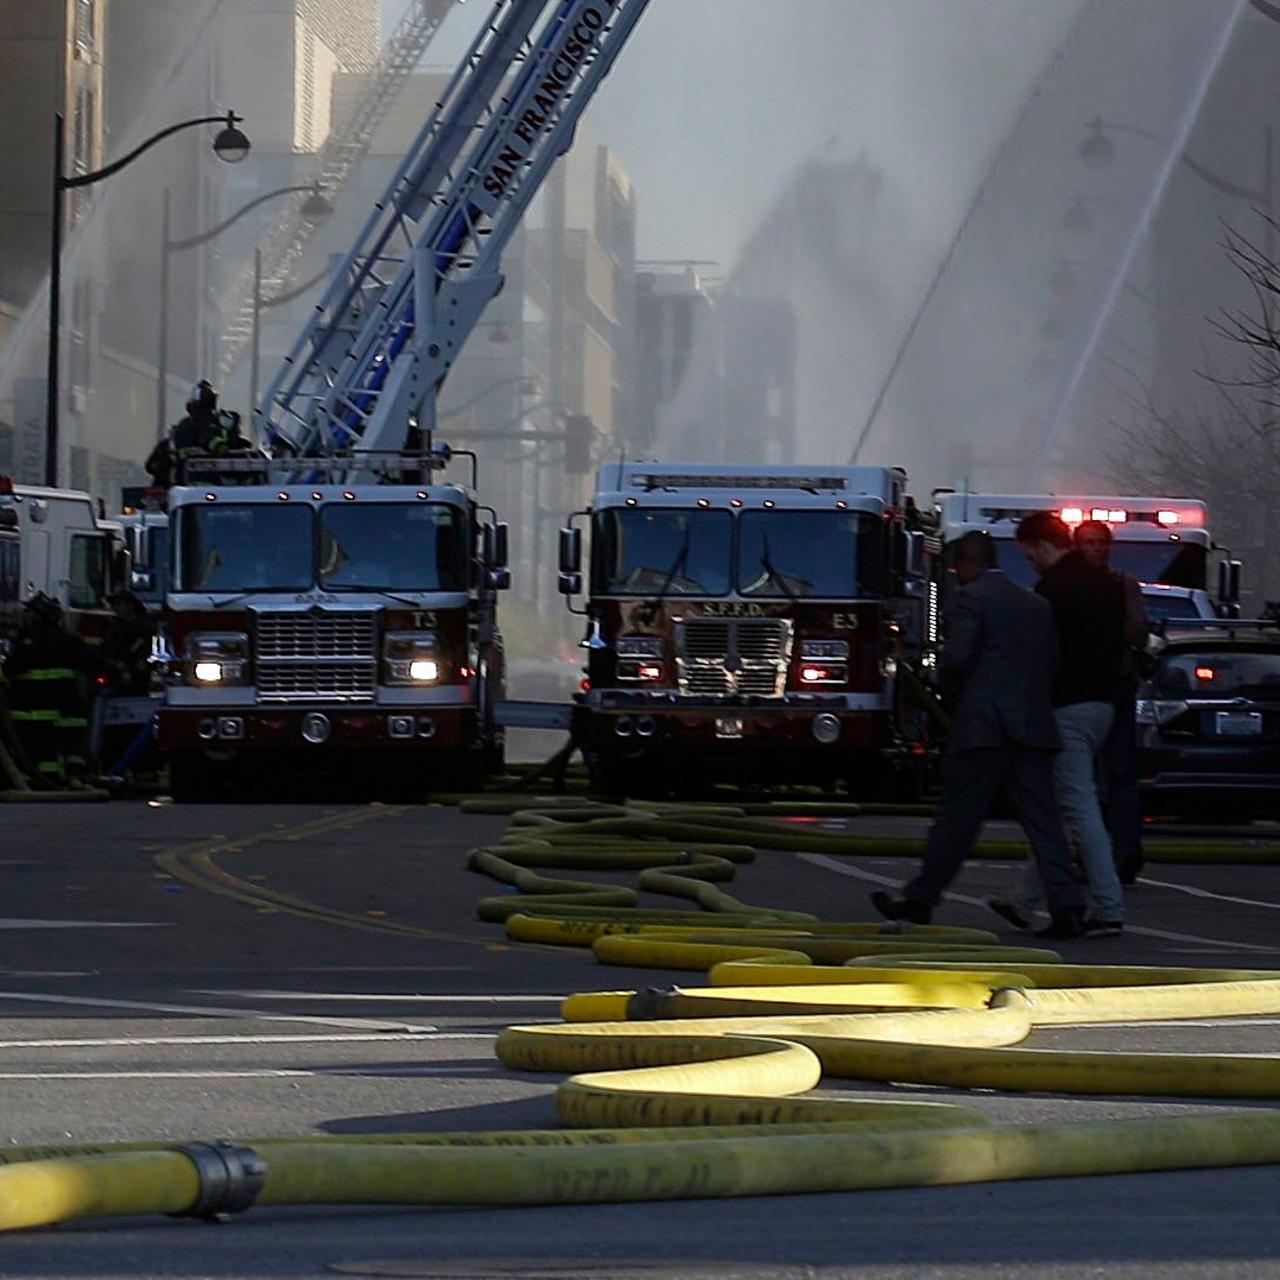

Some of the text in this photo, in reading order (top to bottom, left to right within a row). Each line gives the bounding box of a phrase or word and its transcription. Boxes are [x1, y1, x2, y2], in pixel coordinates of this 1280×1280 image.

[481, 143, 525, 201] SAN
[514, 6, 604, 149] FRANCISCO
[831, 611, 860, 630] E3
